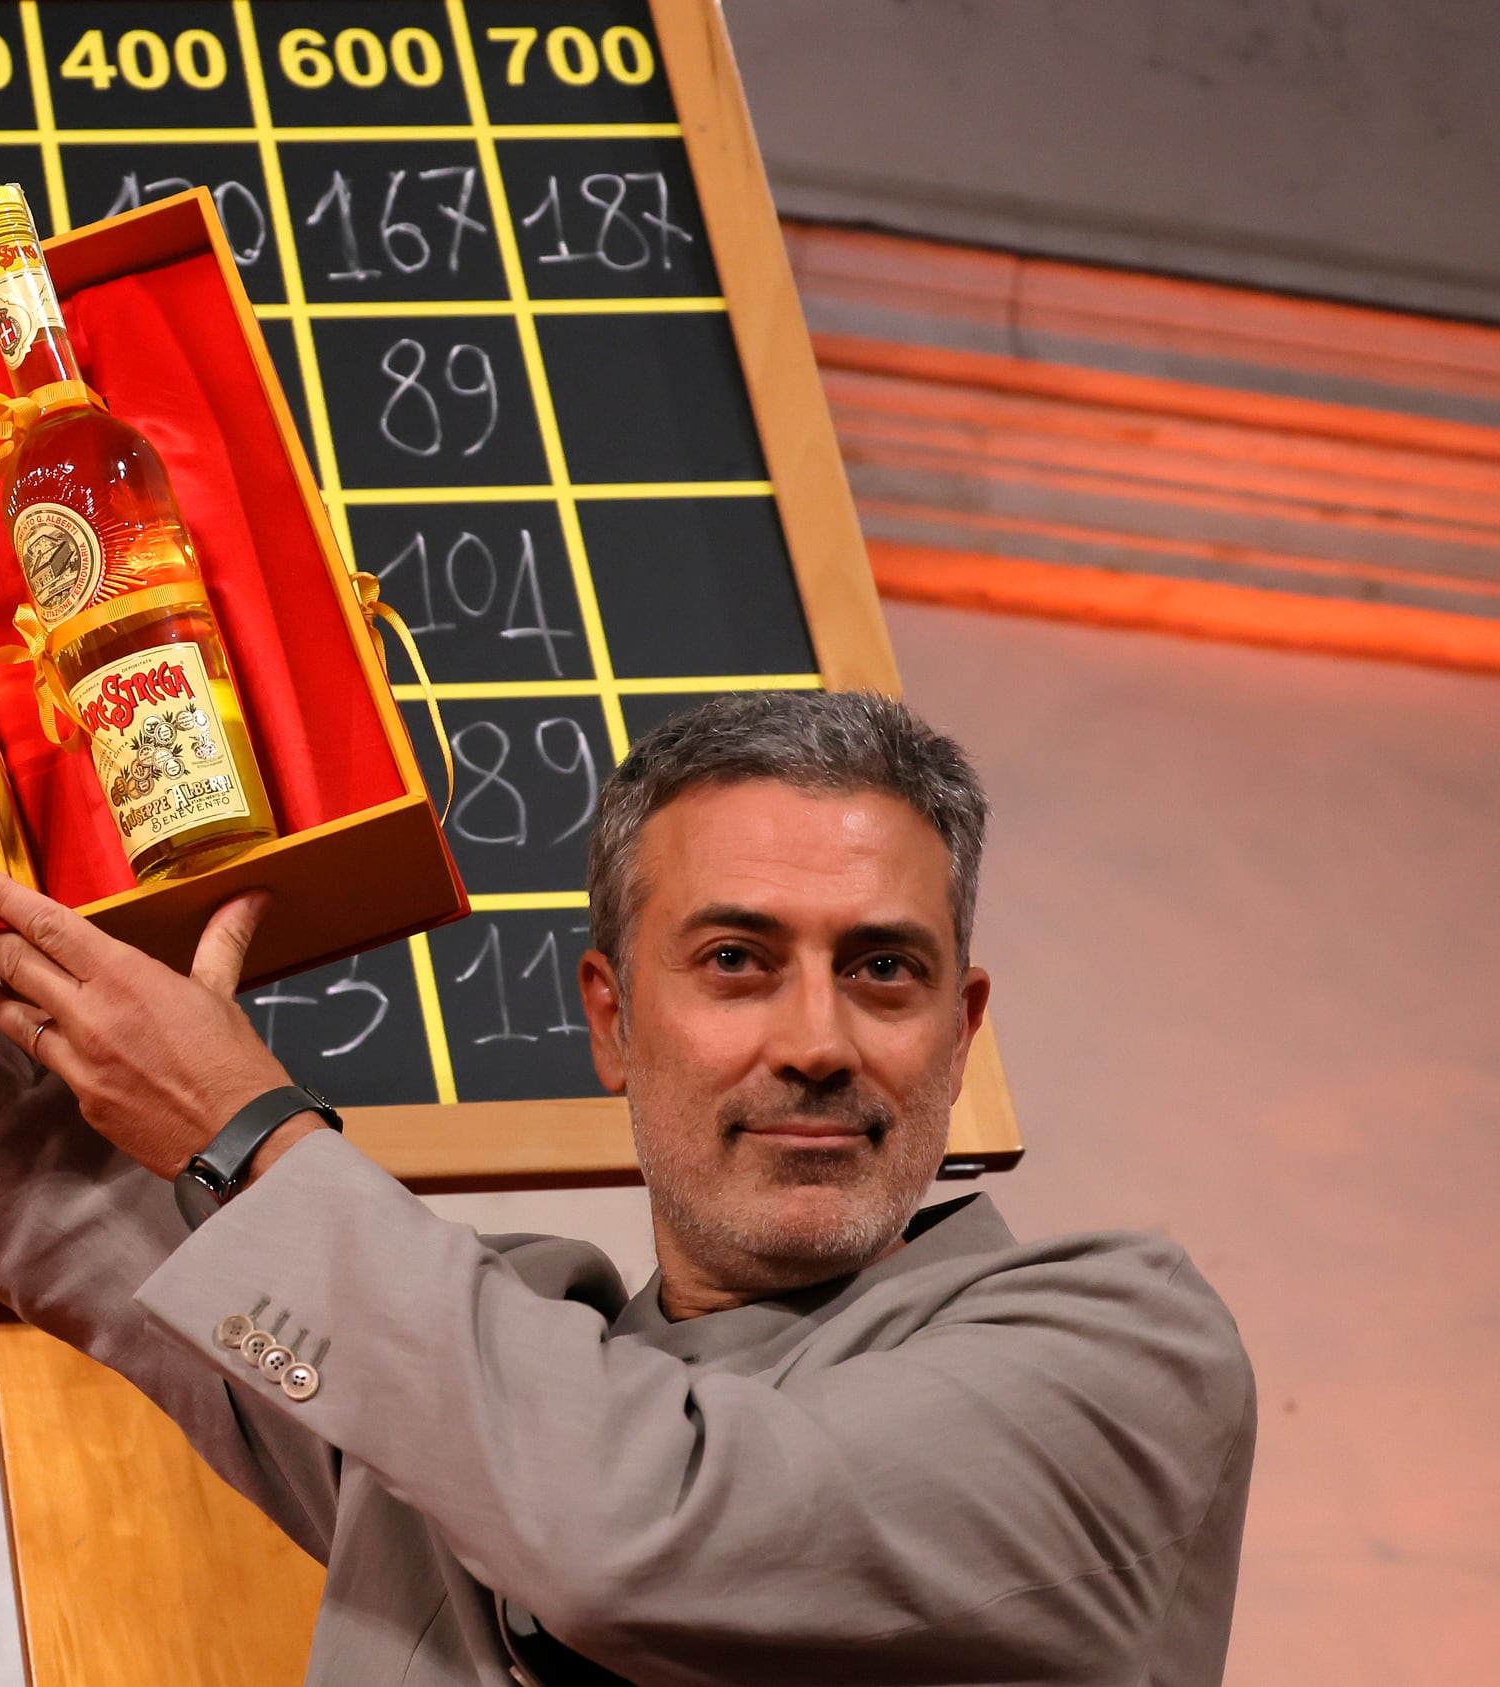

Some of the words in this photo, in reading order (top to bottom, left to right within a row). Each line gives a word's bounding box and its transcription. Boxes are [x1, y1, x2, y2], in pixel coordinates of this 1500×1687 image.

[60, 29, 228, 90] 400
[278, 27, 444, 88] 600
[486, 26, 655, 86] 700
[306, 166, 487, 281] 167
[521, 171, 693, 271] 187
[379, 338, 499, 457] 89
[45, 514, 79, 537] ALBERTI
[71, 542, 91, 600] FERROVIARIA
[101, 660, 195, 737] STREGA
[151, 796, 231, 833] BENEVENTO
[451, 717, 599, 847] 89
[455, 922, 590, 1046] 11
